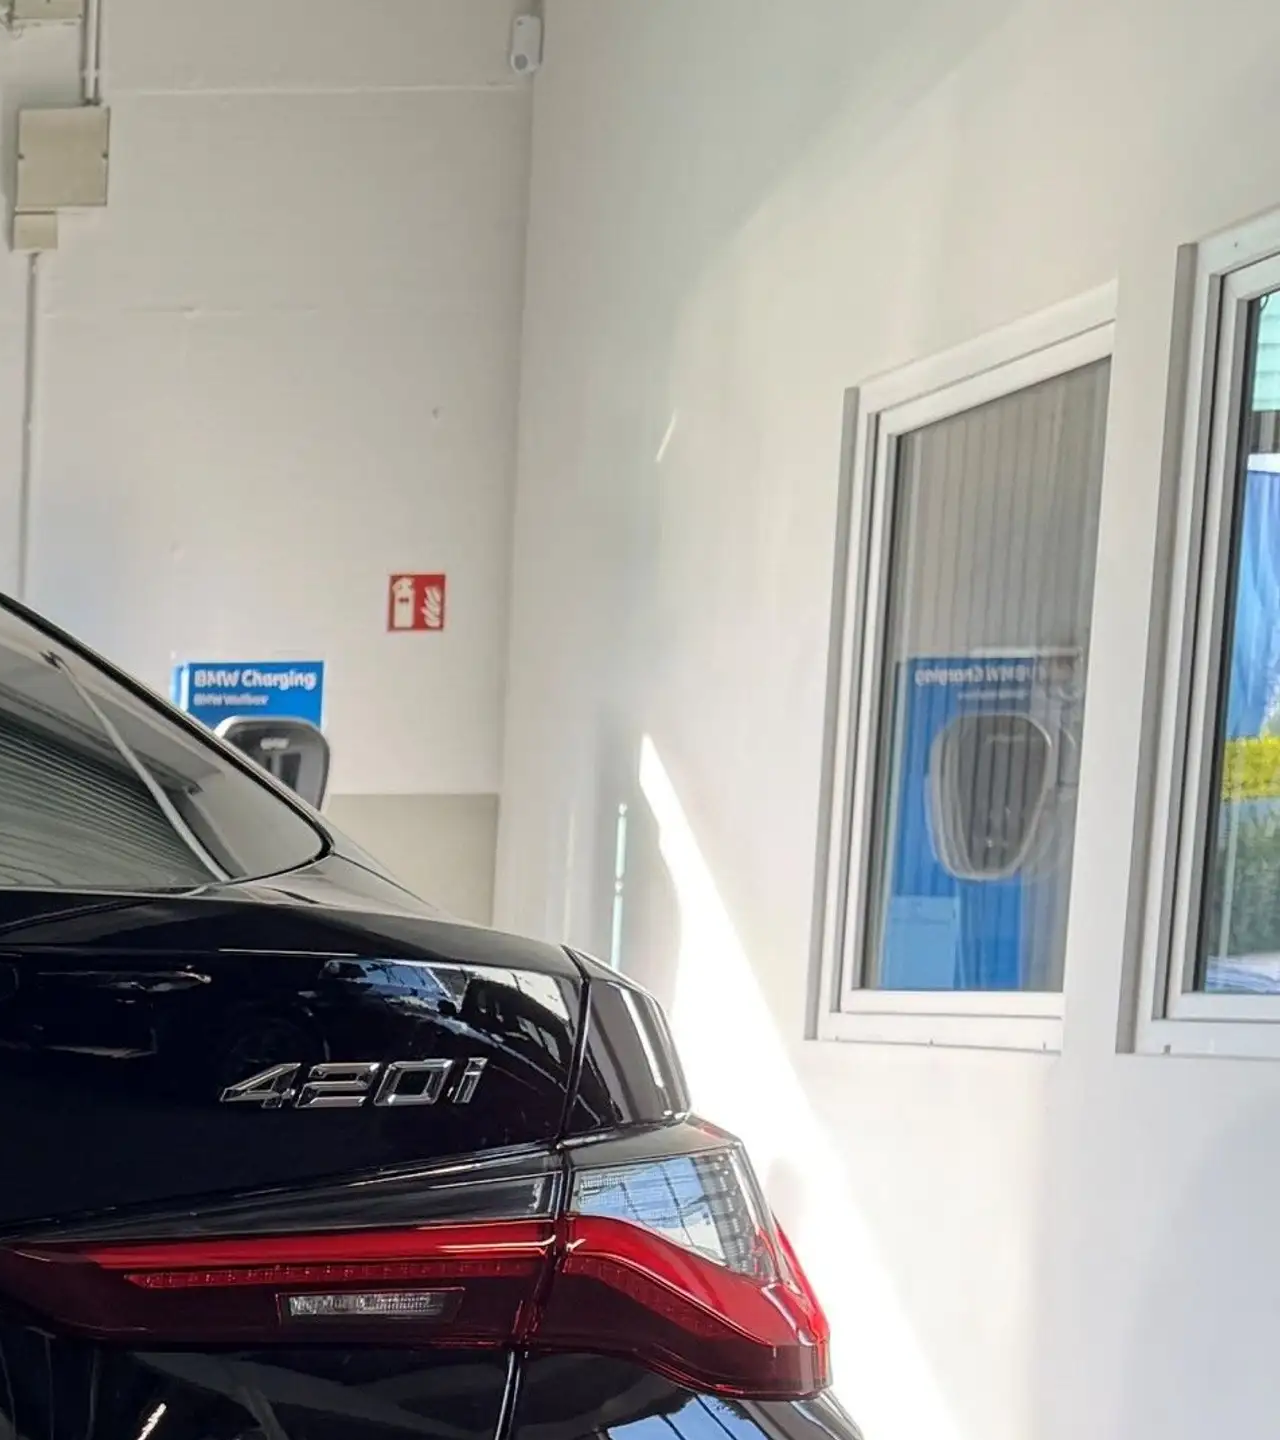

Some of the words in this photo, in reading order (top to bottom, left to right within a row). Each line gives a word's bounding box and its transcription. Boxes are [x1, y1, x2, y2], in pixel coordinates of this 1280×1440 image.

[194, 669, 239, 688] BMW
[241, 669, 317, 691] Charging
[219, 1057, 488, 1108] 420i
